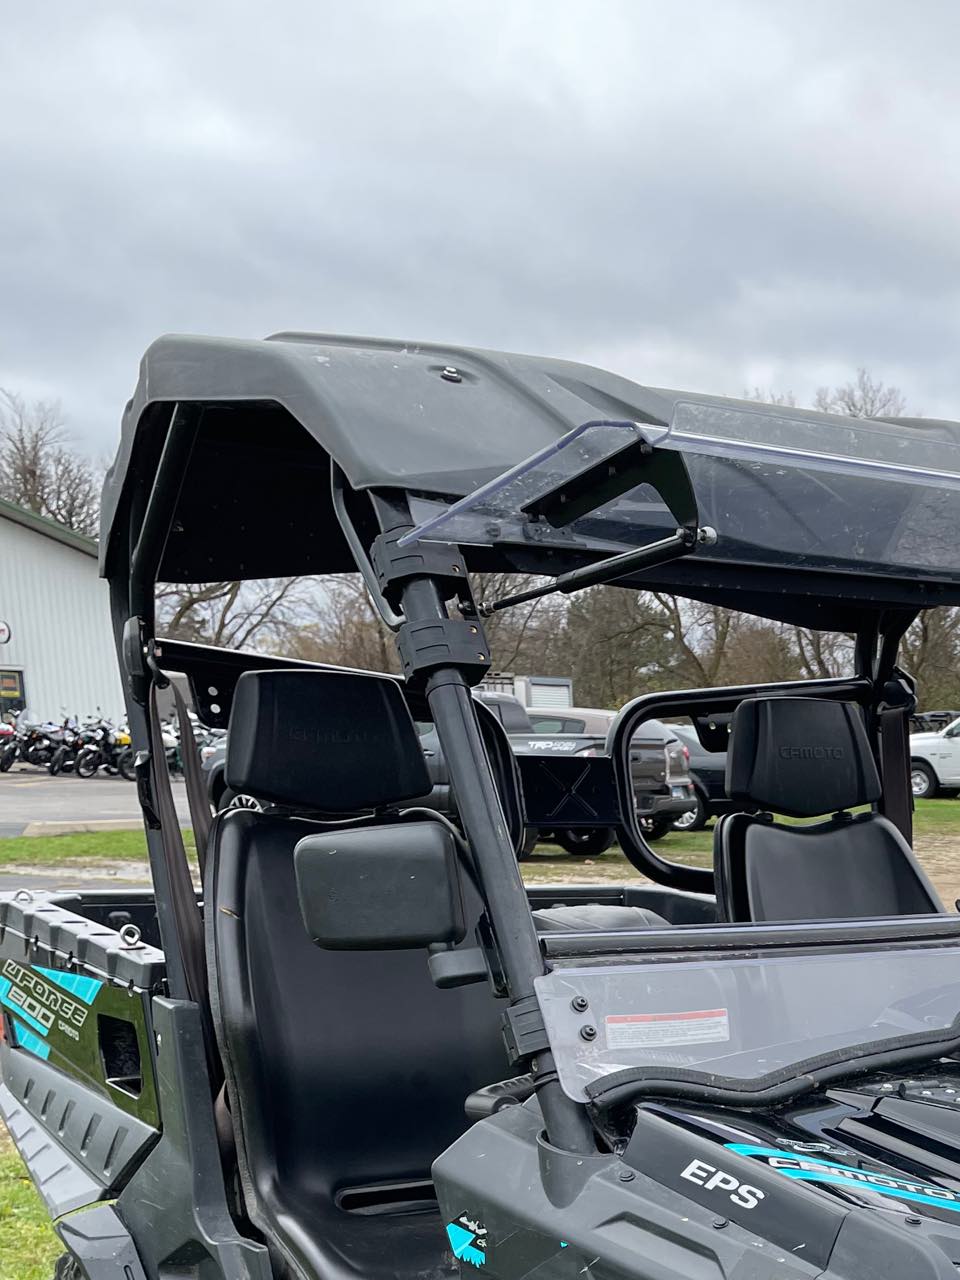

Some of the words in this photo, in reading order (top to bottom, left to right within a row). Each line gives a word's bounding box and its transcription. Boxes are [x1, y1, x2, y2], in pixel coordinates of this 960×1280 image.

[8, 986, 55, 1029] 800
[679, 1158, 766, 1210] EPS
[768, 1156, 957, 1200] CFMOTO
